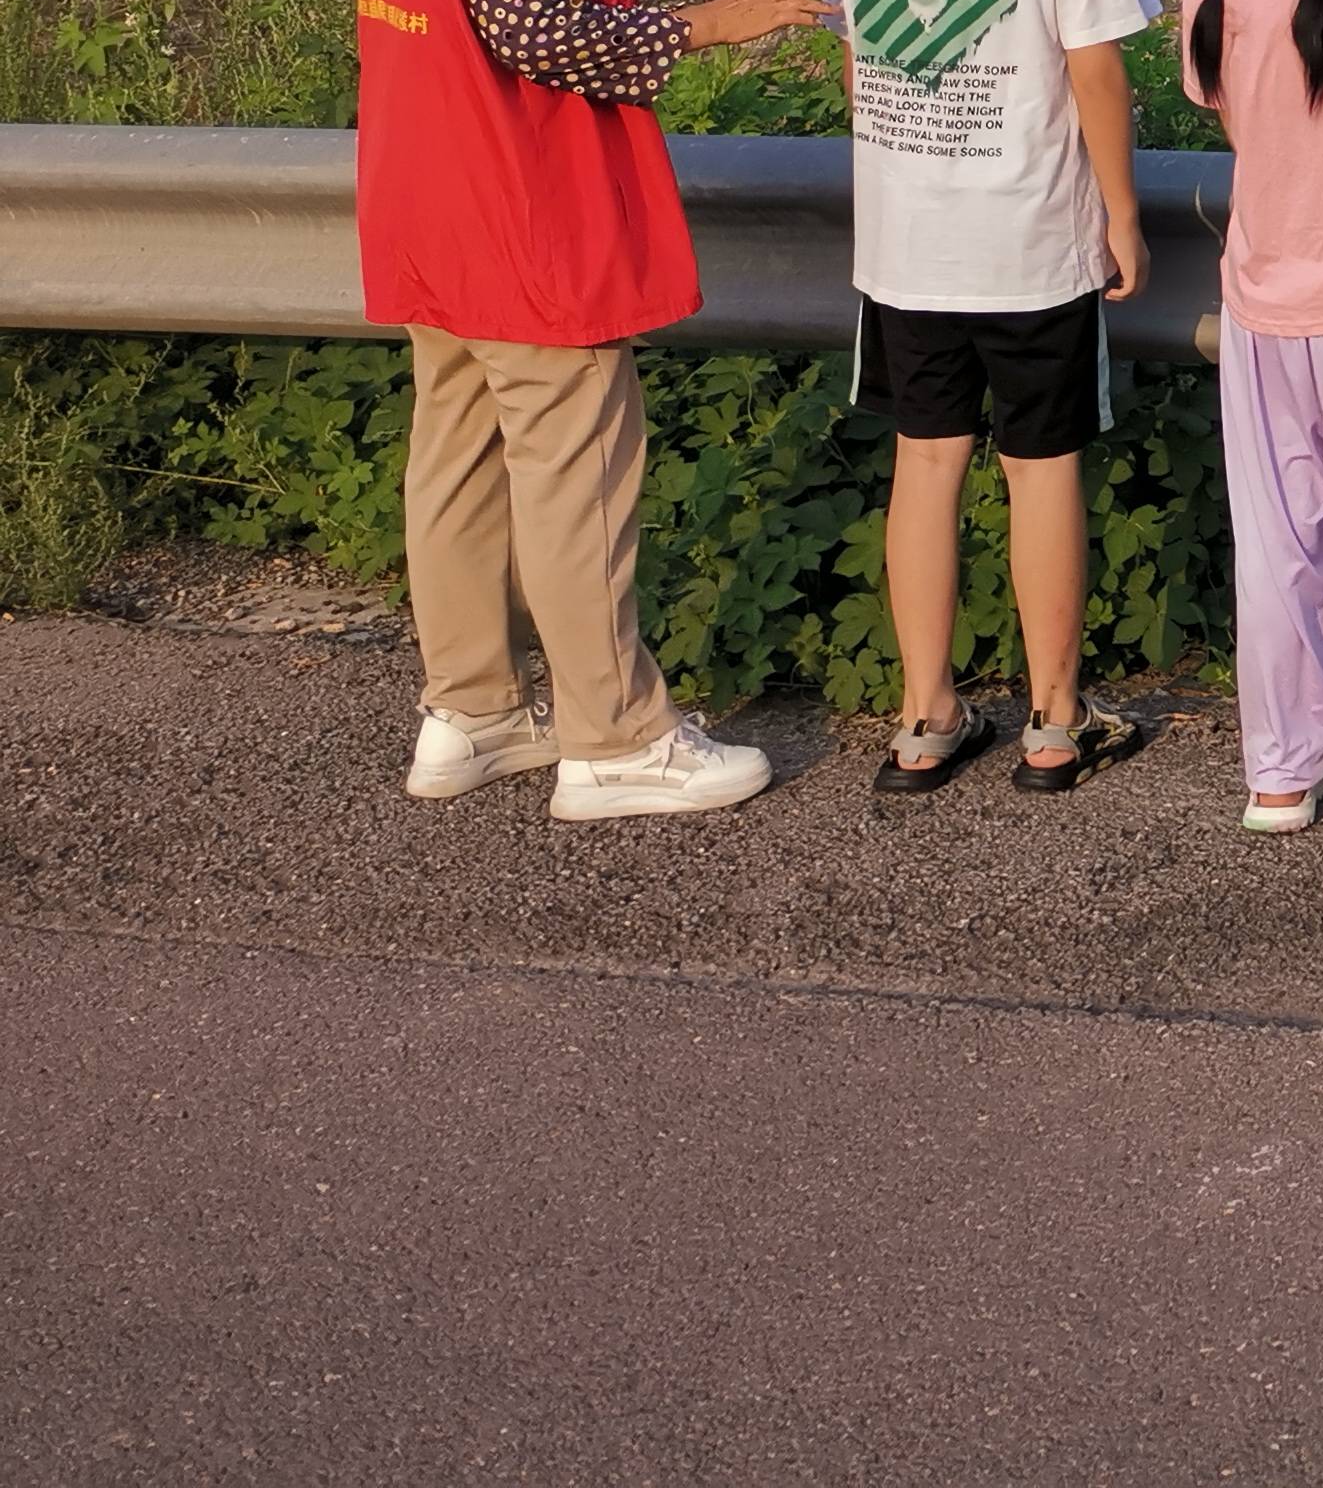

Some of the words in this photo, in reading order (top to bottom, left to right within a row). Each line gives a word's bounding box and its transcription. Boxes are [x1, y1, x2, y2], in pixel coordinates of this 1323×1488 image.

[879, 55, 906, 69] SOME
[984, 65, 1019, 76] SOME
[858, 68, 903, 83] FLOWERS
[905, 73, 930, 84] AND
[963, 79, 998, 89] SOME
[861, 81, 892, 94] FRESH
[894, 86, 930, 98] WATER
[969, 92, 991, 102] THE
[896, 100, 927, 112] LOOK
[930, 103, 941, 114] TO
[943, 105, 964, 116] THE
[967, 106, 1004, 116] NIGHT
[909, 115, 923, 125] TO
[927, 117, 943, 128] THE
[945, 120, 982, 130] MOON
[985, 120, 1003, 129] ON
[885, 126, 933, 141] FESTIVAL
[936, 132, 969, 143] NIGHT
[897, 142, 924, 154] SING
[926, 145, 957, 157] SOME
[960, 146, 1003, 157] SONGS
